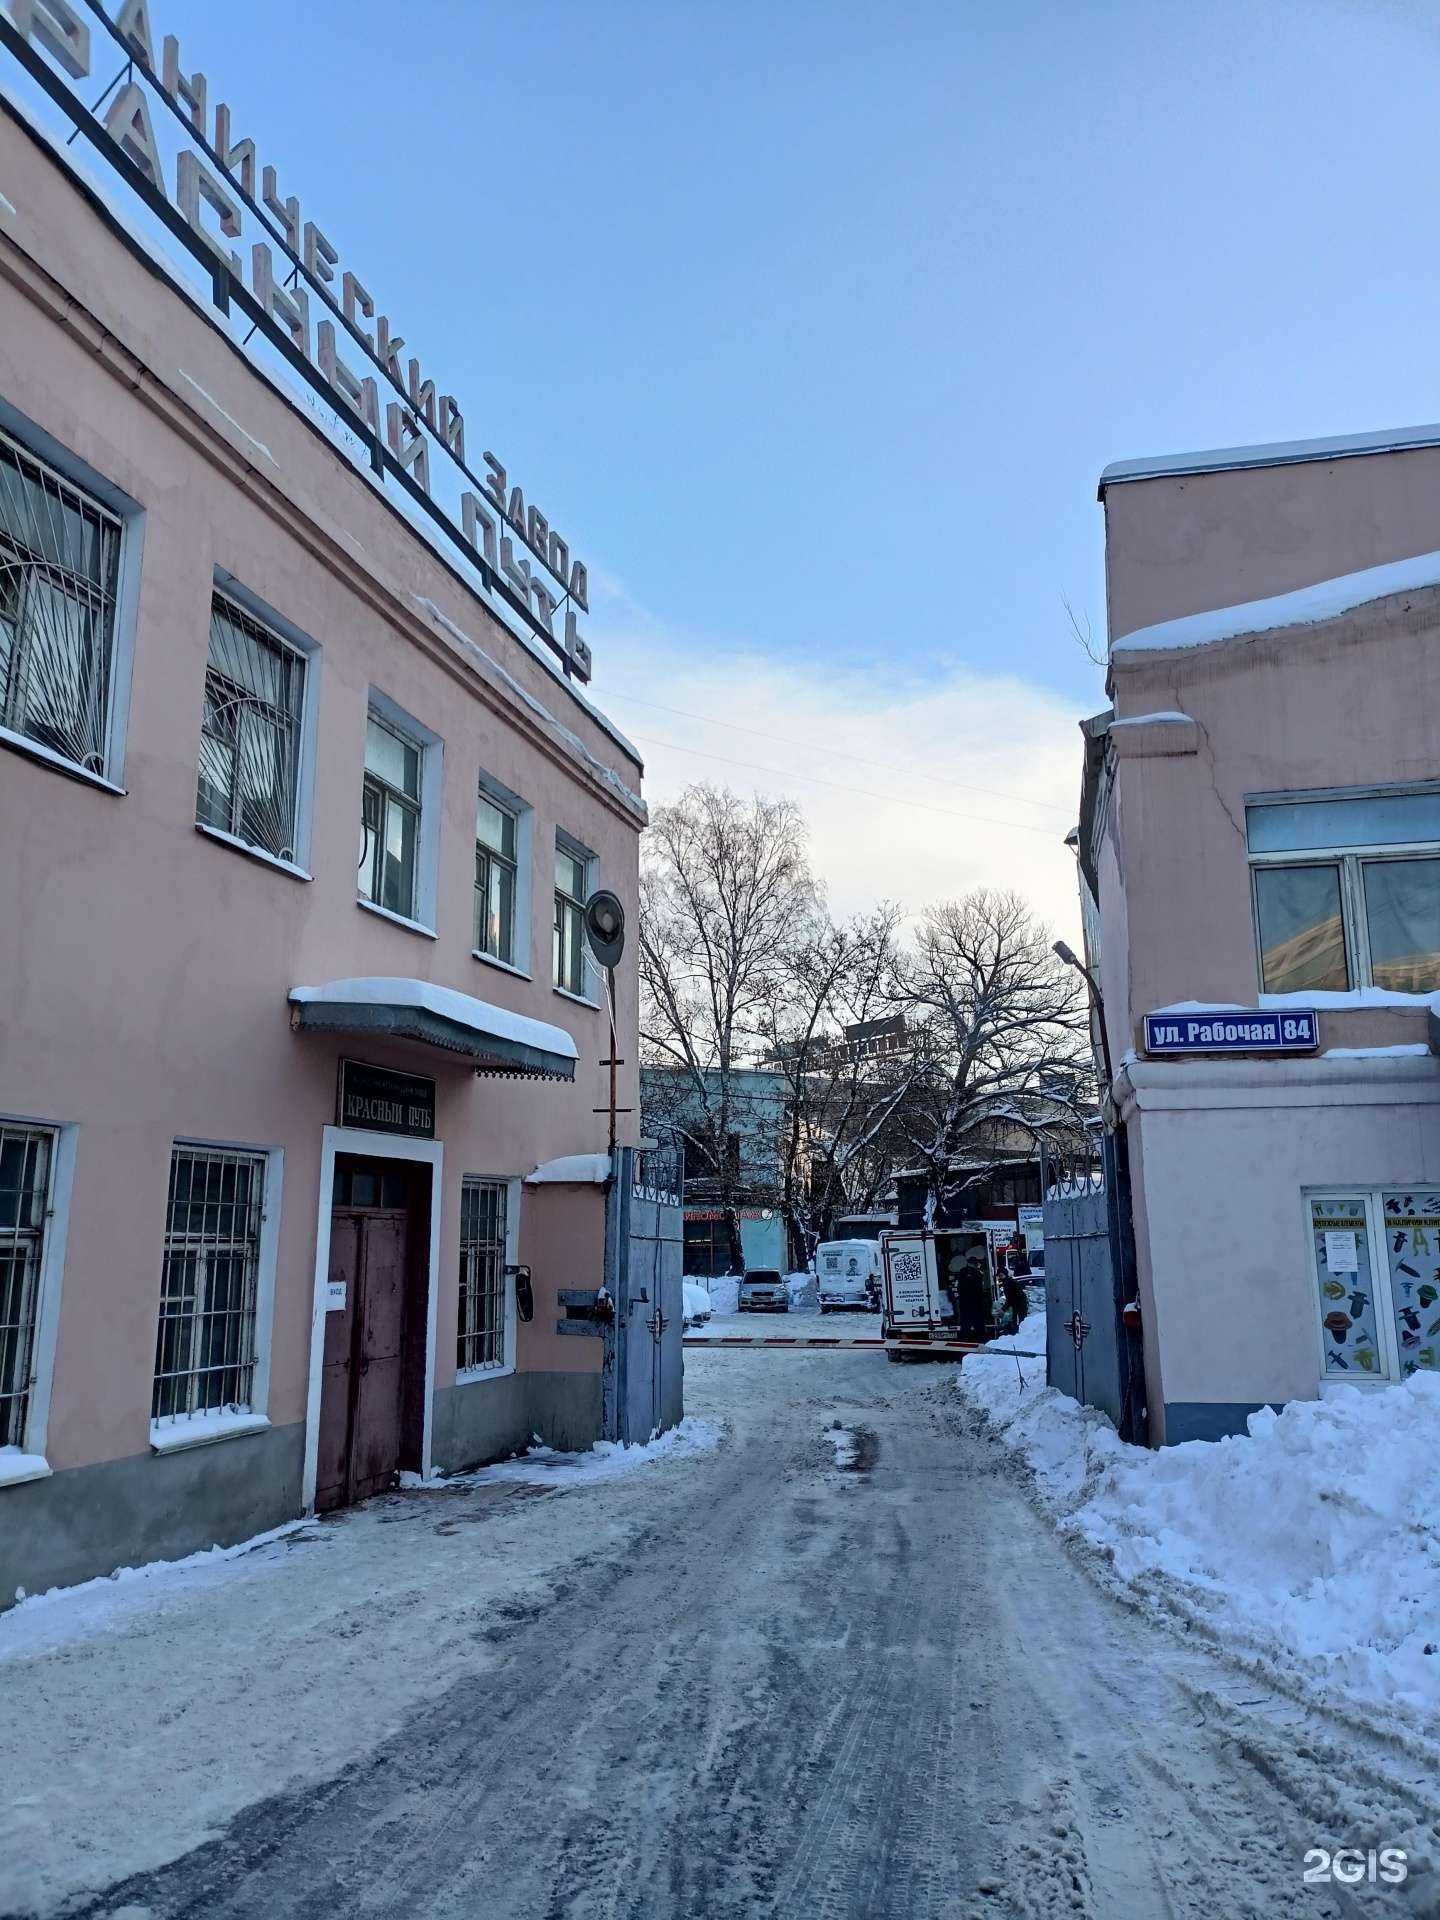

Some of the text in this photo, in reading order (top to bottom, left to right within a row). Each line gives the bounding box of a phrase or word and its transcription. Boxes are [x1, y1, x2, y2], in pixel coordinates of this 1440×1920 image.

[483, 451, 589, 612] ЗАВОД
[461, 492, 592, 682] ПУТЬ
[1153, 1019, 1311, 1045] ул. Рабочая 84
[408, 1106, 431, 1129] ПУТЬ
